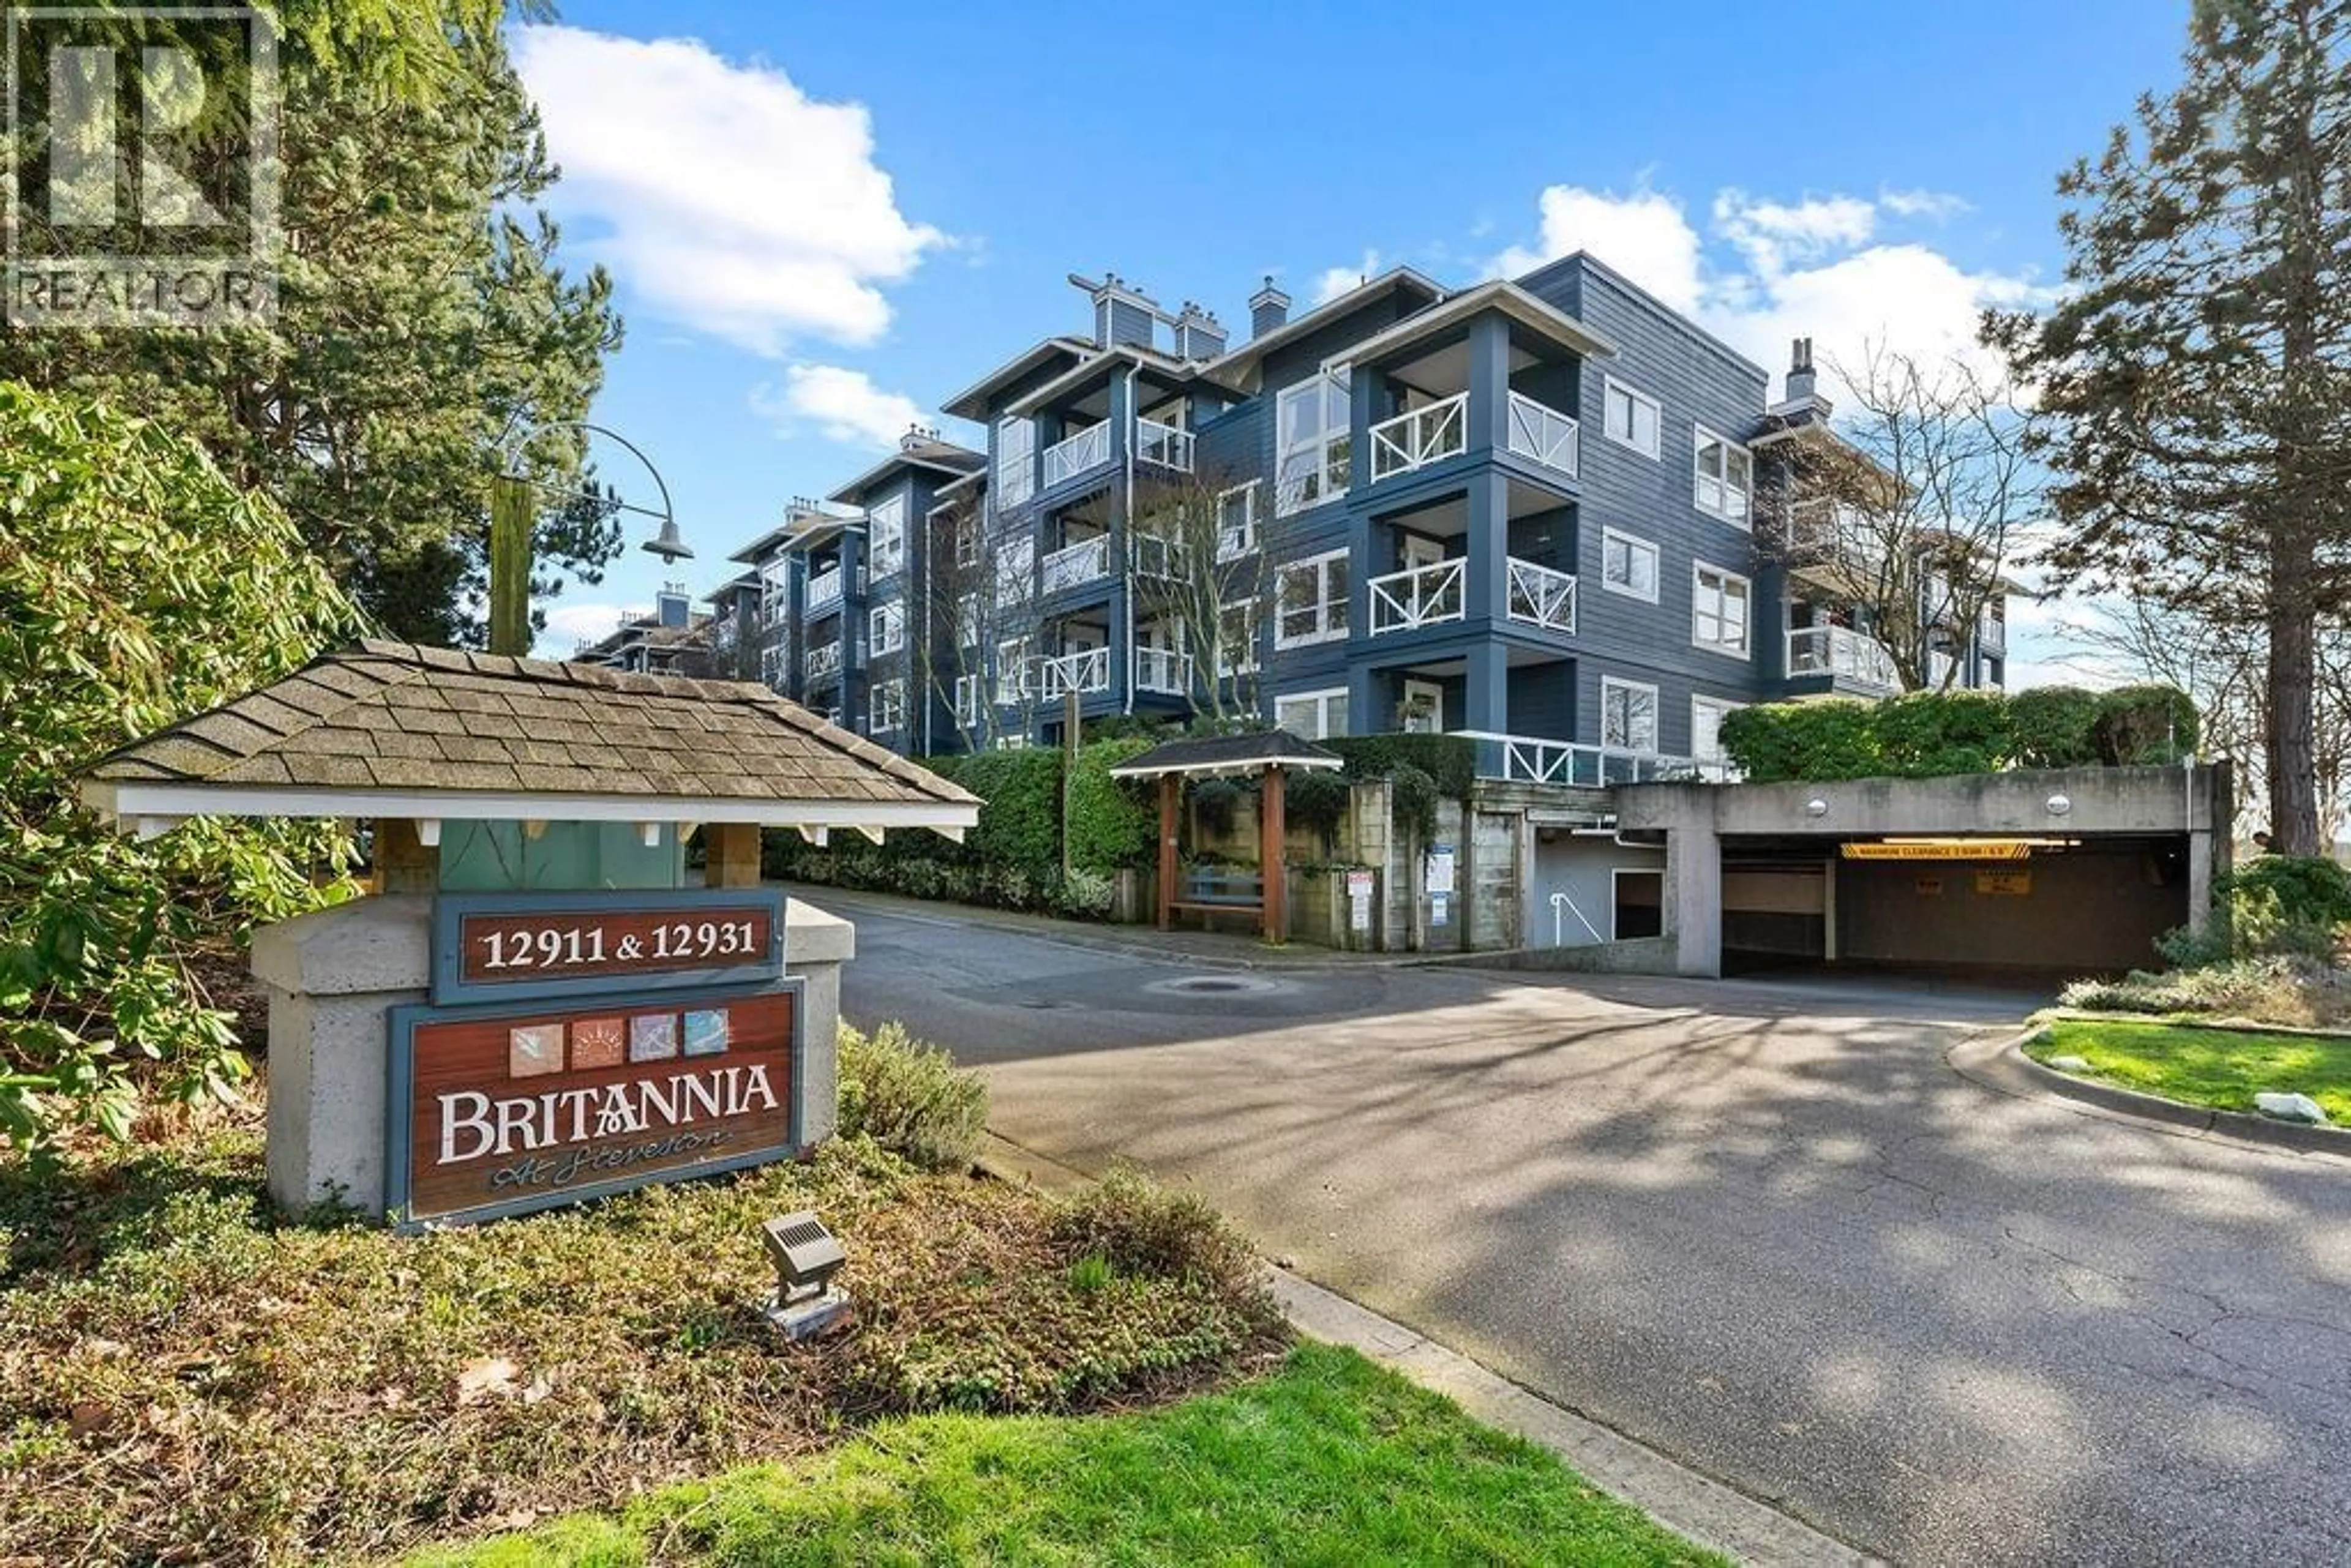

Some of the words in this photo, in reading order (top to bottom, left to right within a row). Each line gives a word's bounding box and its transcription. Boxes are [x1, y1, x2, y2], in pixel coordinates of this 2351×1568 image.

[484, 926, 607, 968] 12911
[615, 934, 644, 960] &
[652, 921, 756, 958] 12931
